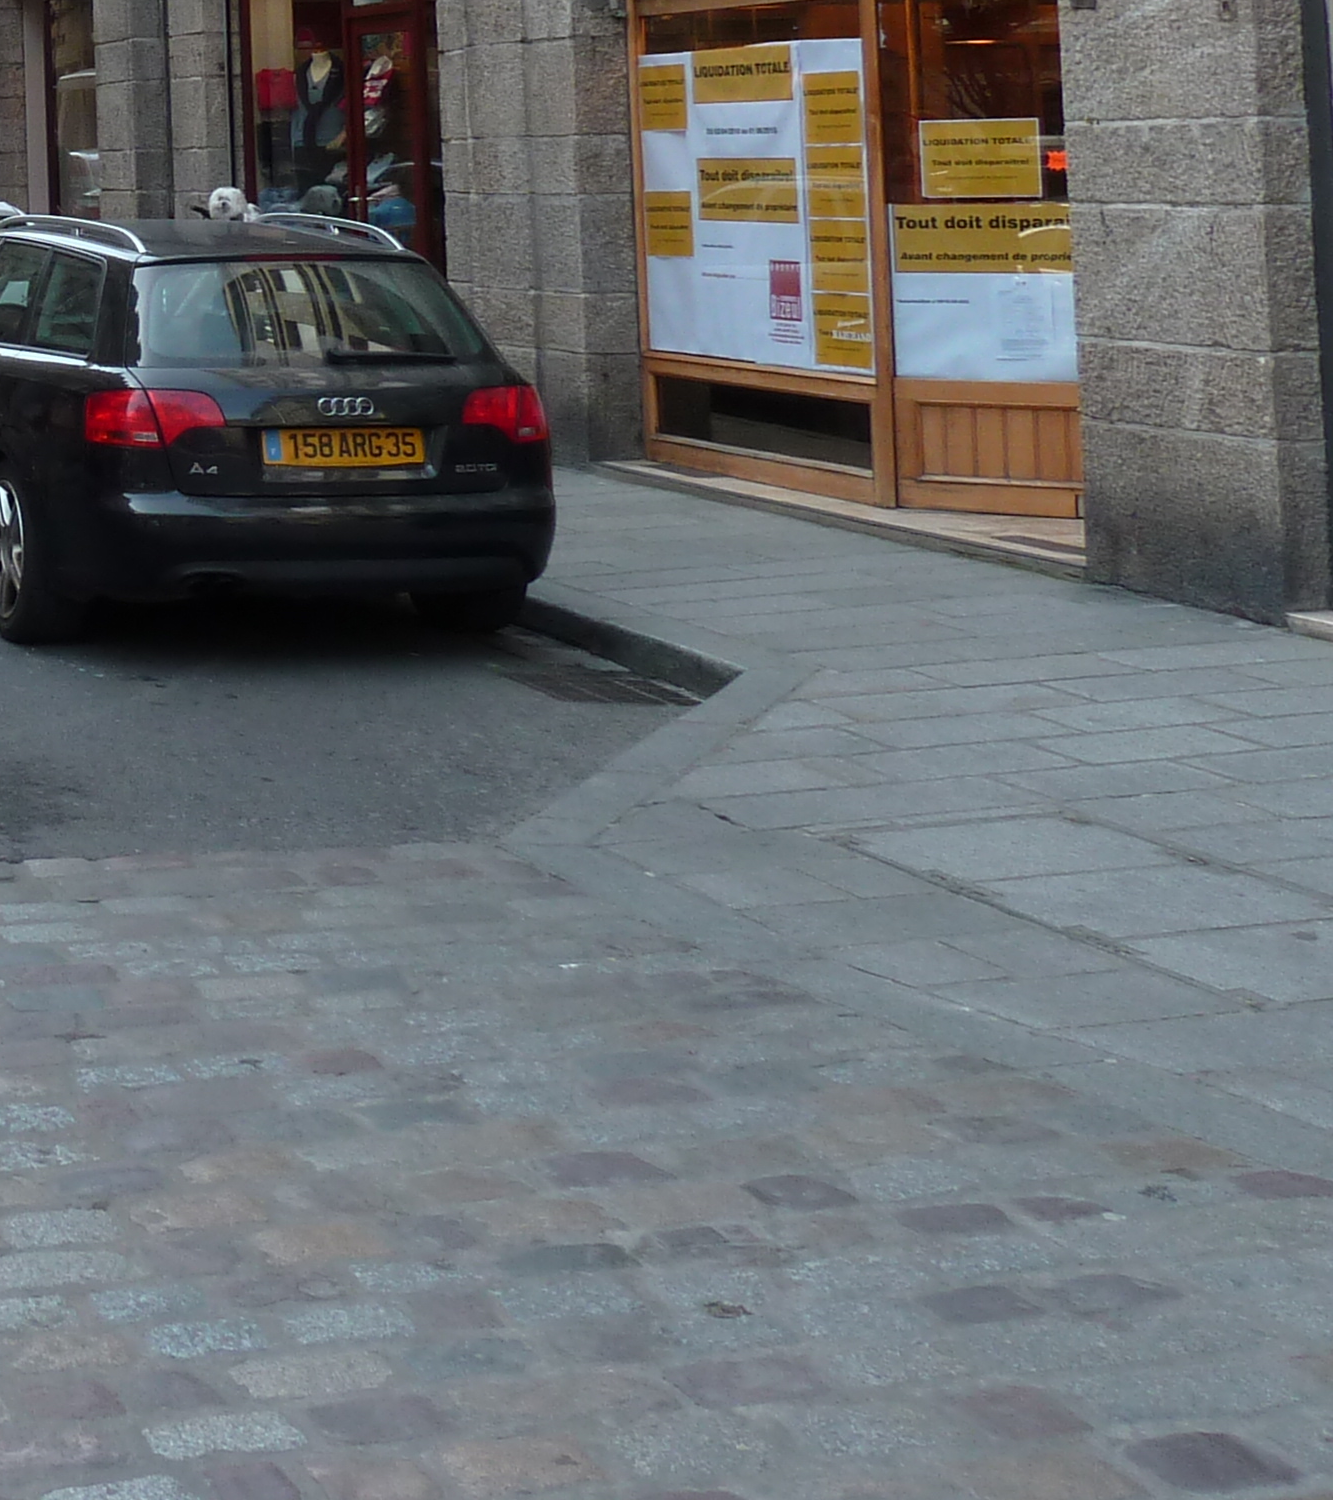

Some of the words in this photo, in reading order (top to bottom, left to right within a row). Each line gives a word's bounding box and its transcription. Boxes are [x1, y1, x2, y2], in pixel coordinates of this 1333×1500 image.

[693, 63, 753, 79] LIQUIDATION
[754, 60, 790, 76] TOTALE
[922, 138, 989, 147] LIQUIDATION
[699, 169, 720, 182] Tout
[721, 169, 741, 182] doit
[895, 216, 939, 230] Tout
[944, 215, 983, 230] doit
[900, 252, 933, 261] Avant
[935, 252, 1010, 262] changement
[1012, 252, 1027, 261] de
[288, 432, 333, 459] 158
[338, 432, 383, 458] ARG
[384, 432, 416, 458] 35
[189, 461, 218, 476] A4
